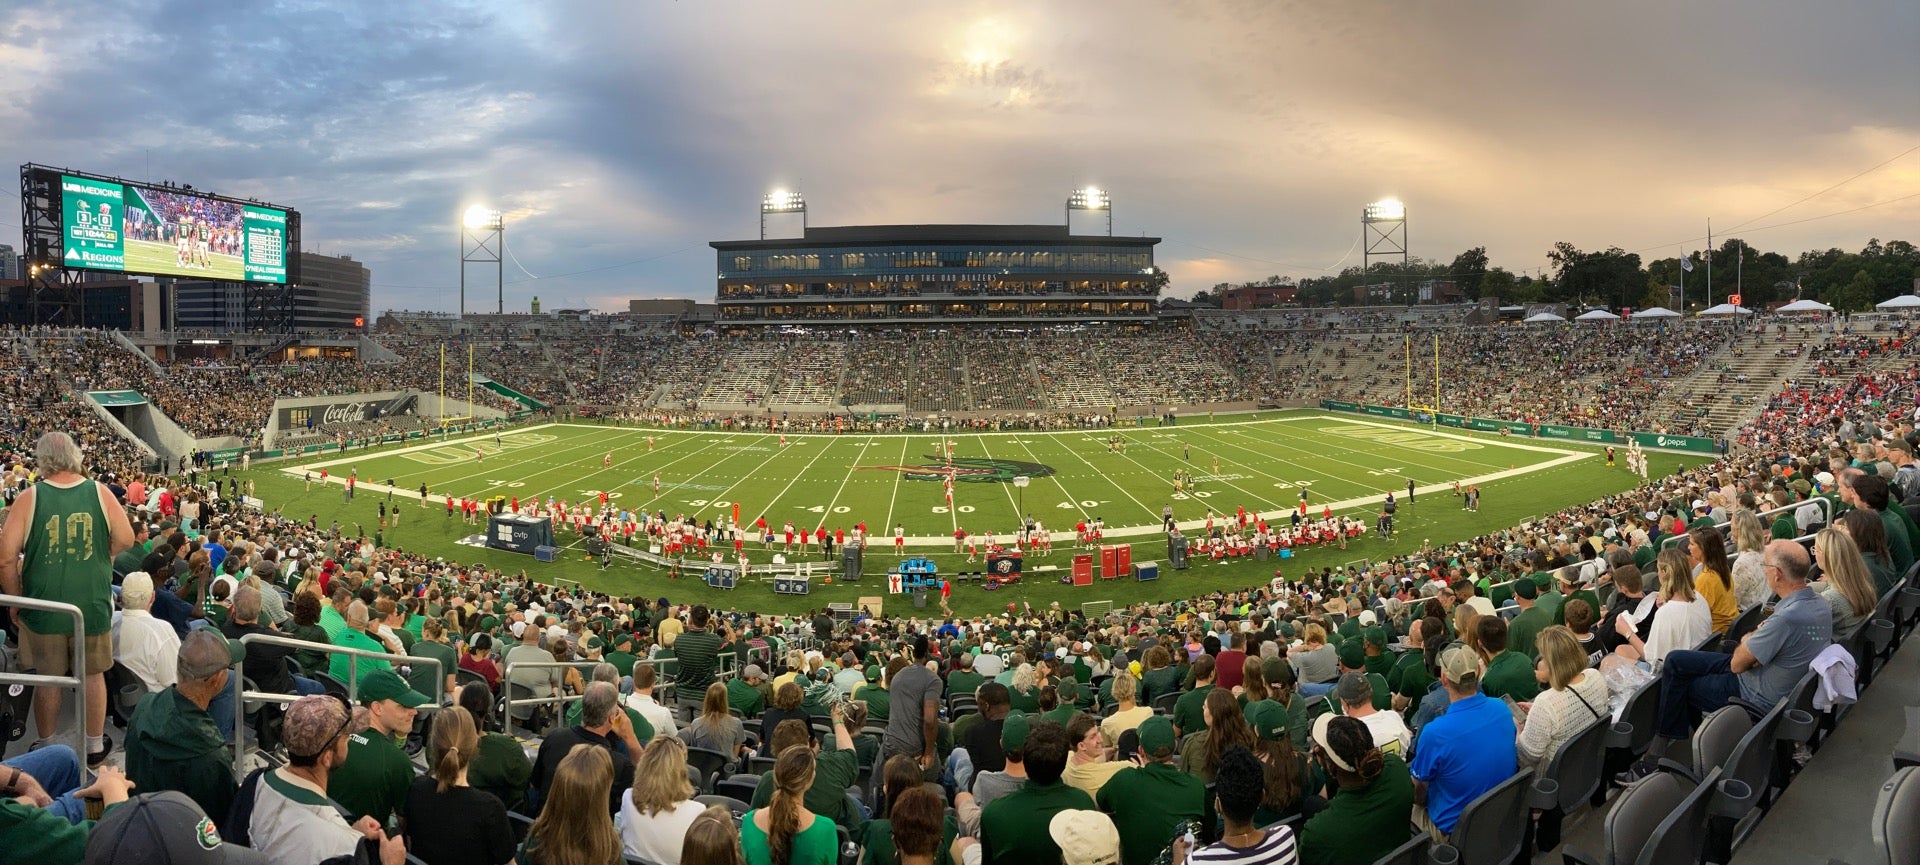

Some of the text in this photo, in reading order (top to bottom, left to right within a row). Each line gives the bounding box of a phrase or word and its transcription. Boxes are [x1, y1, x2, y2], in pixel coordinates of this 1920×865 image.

[81, 185, 122, 199] MEDICINE
[81, 213, 109, 225] 3 0
[82, 251, 124, 264] REGIONS
[877, 275, 899, 283] HOME
[921, 274, 936, 282] THE
[961, 274, 997, 282] BLAZERS
[1667, 438, 1687, 447] pepsi
